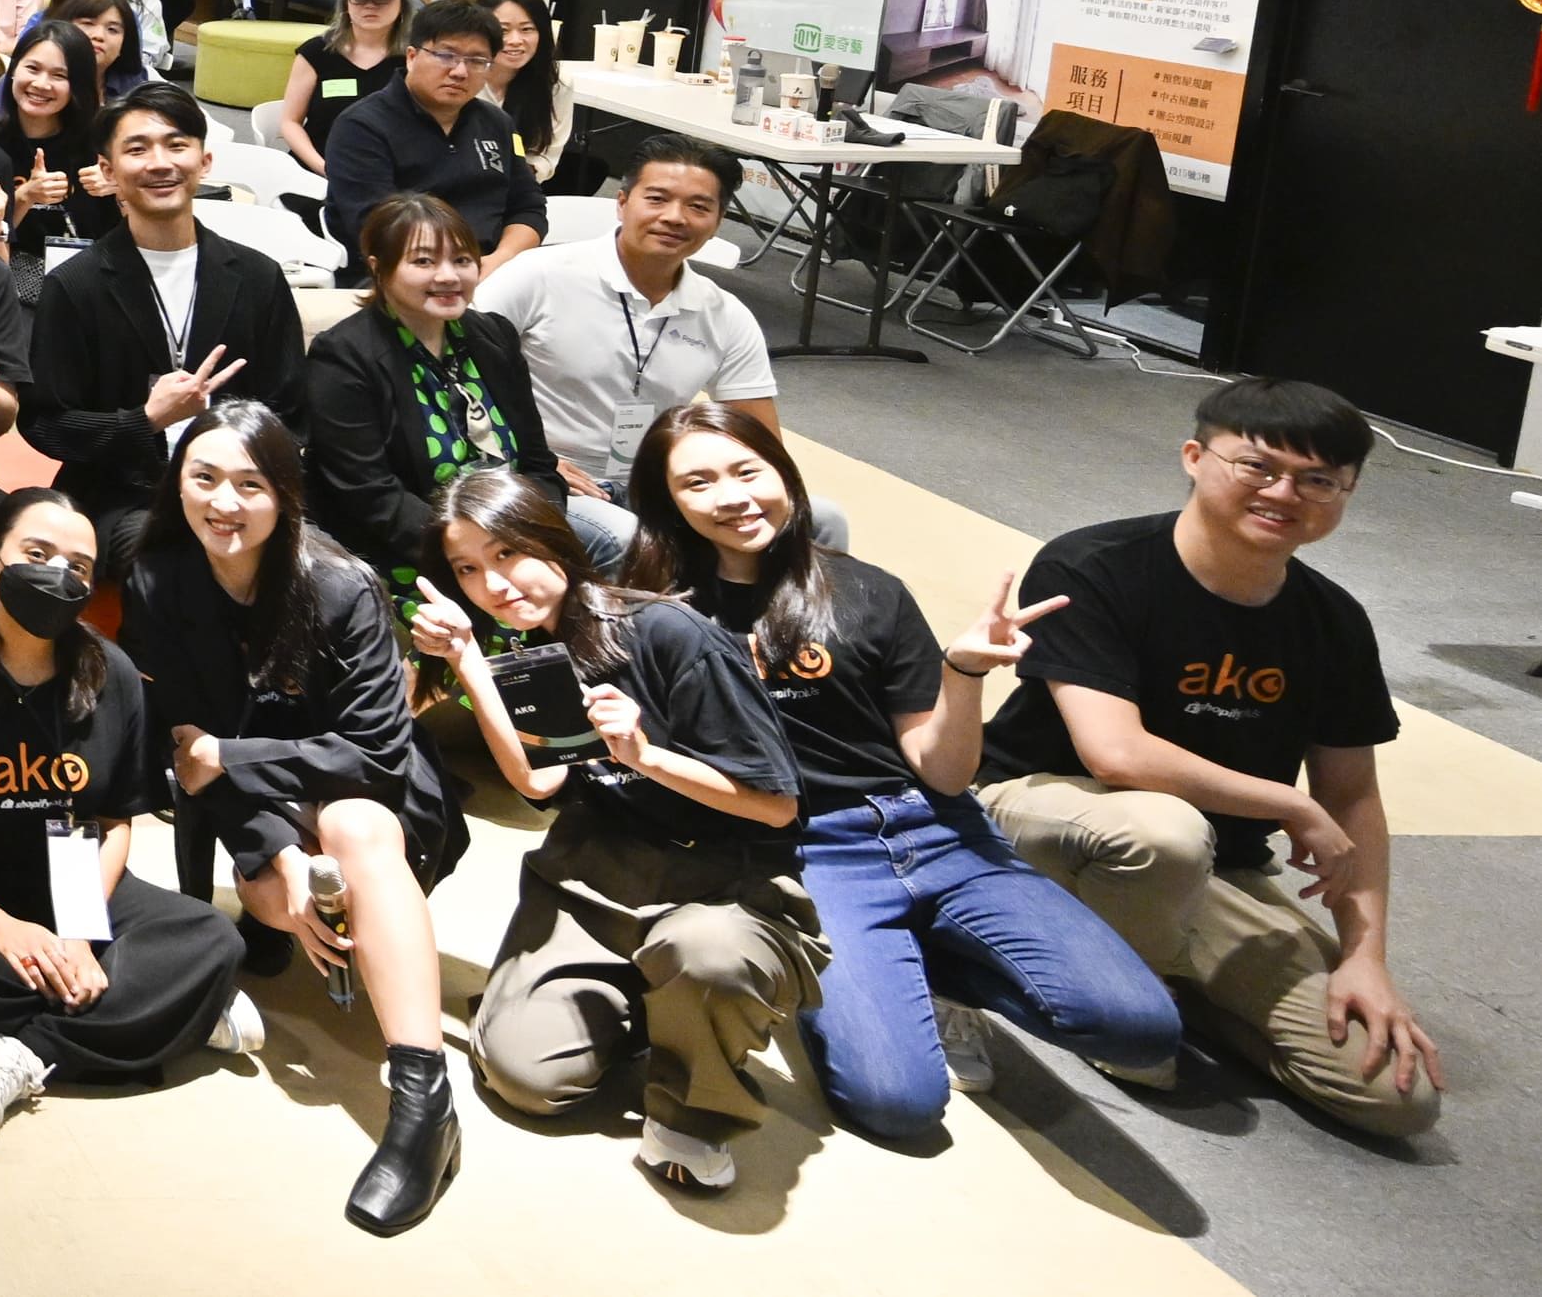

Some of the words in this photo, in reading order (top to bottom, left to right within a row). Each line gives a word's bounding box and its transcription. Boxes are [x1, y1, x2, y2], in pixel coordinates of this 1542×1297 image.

[1070, 65, 1108, 89] 服務
[1067, 91, 1103, 114] 項目
[1177, 653, 1286, 703] ako
[515, 705, 536, 715] AKO
